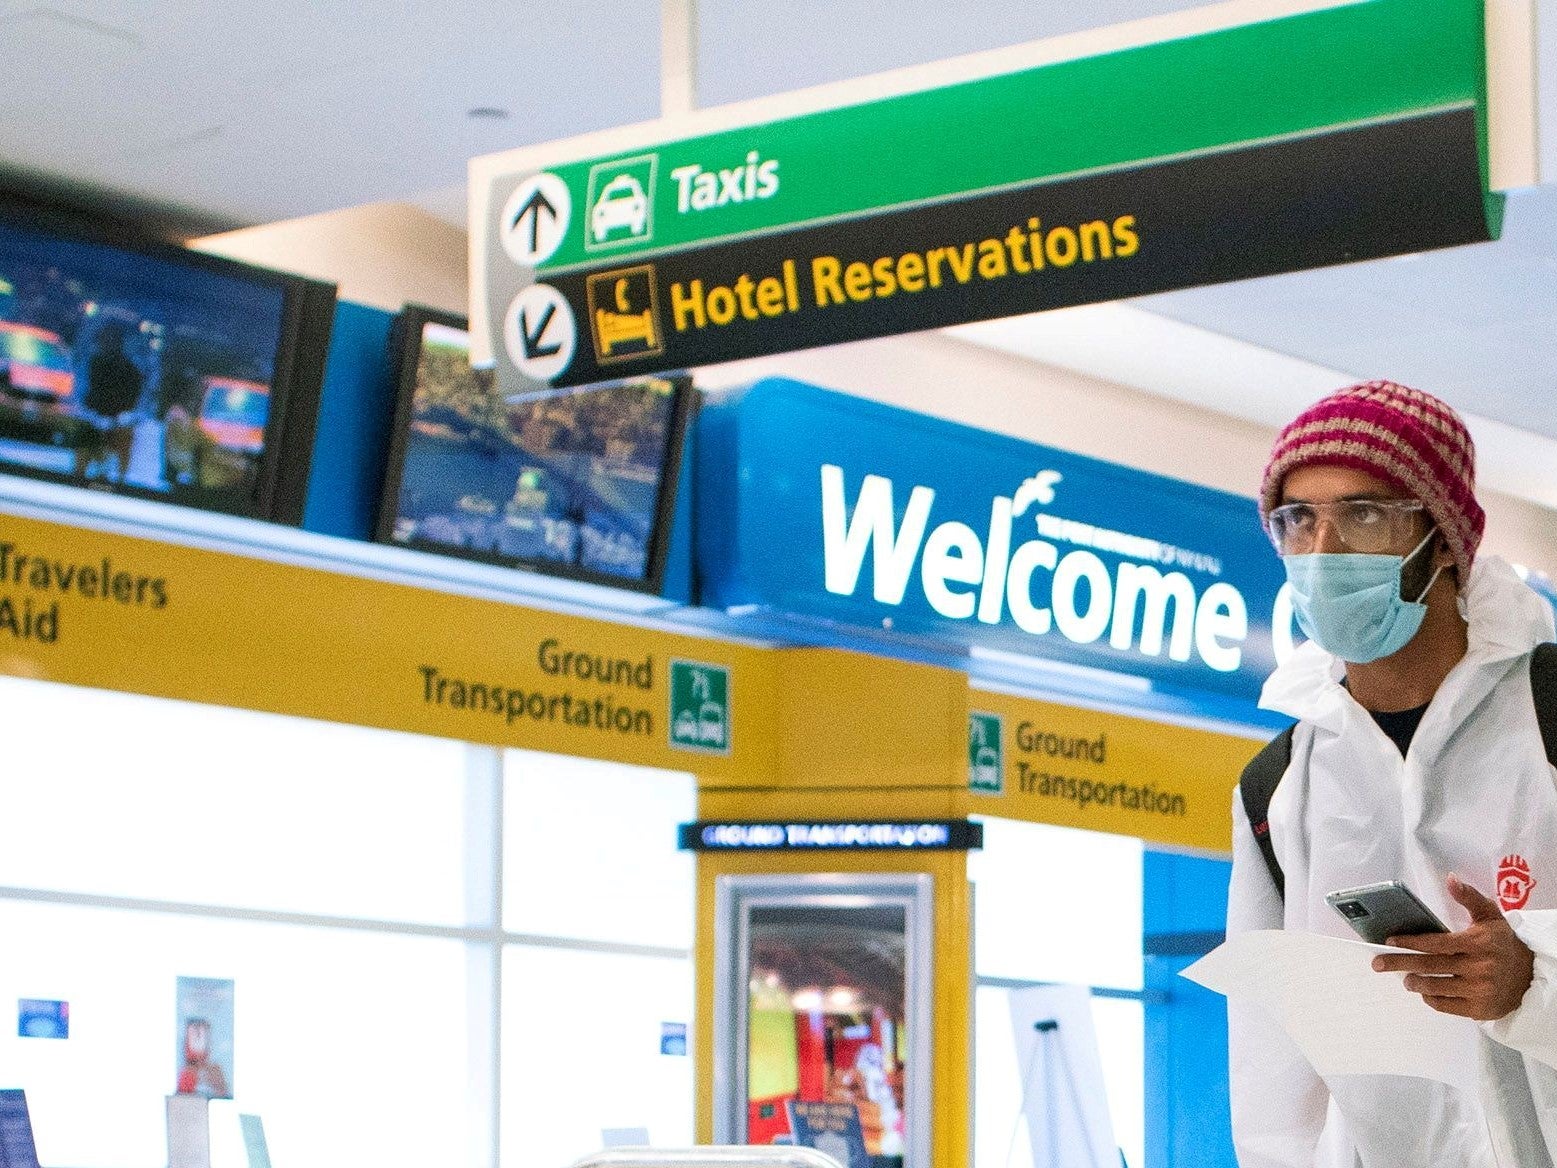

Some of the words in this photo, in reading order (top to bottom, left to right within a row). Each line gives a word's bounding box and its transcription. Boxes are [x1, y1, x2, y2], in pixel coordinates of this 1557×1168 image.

[669, 150, 780, 214] Taxis
[670, 259, 799, 332] Hotel
[811, 214, 1140, 308] Reservations
[0, 541, 168, 609] Travelers
[821, 463, 1249, 673] Welcome
[0, 596, 59, 644] Aid
[537, 638, 653, 690] Ground
[418, 664, 653, 735] Transportation
[1016, 720, 1106, 764] Ground
[1017, 761, 1187, 816] Transportation
